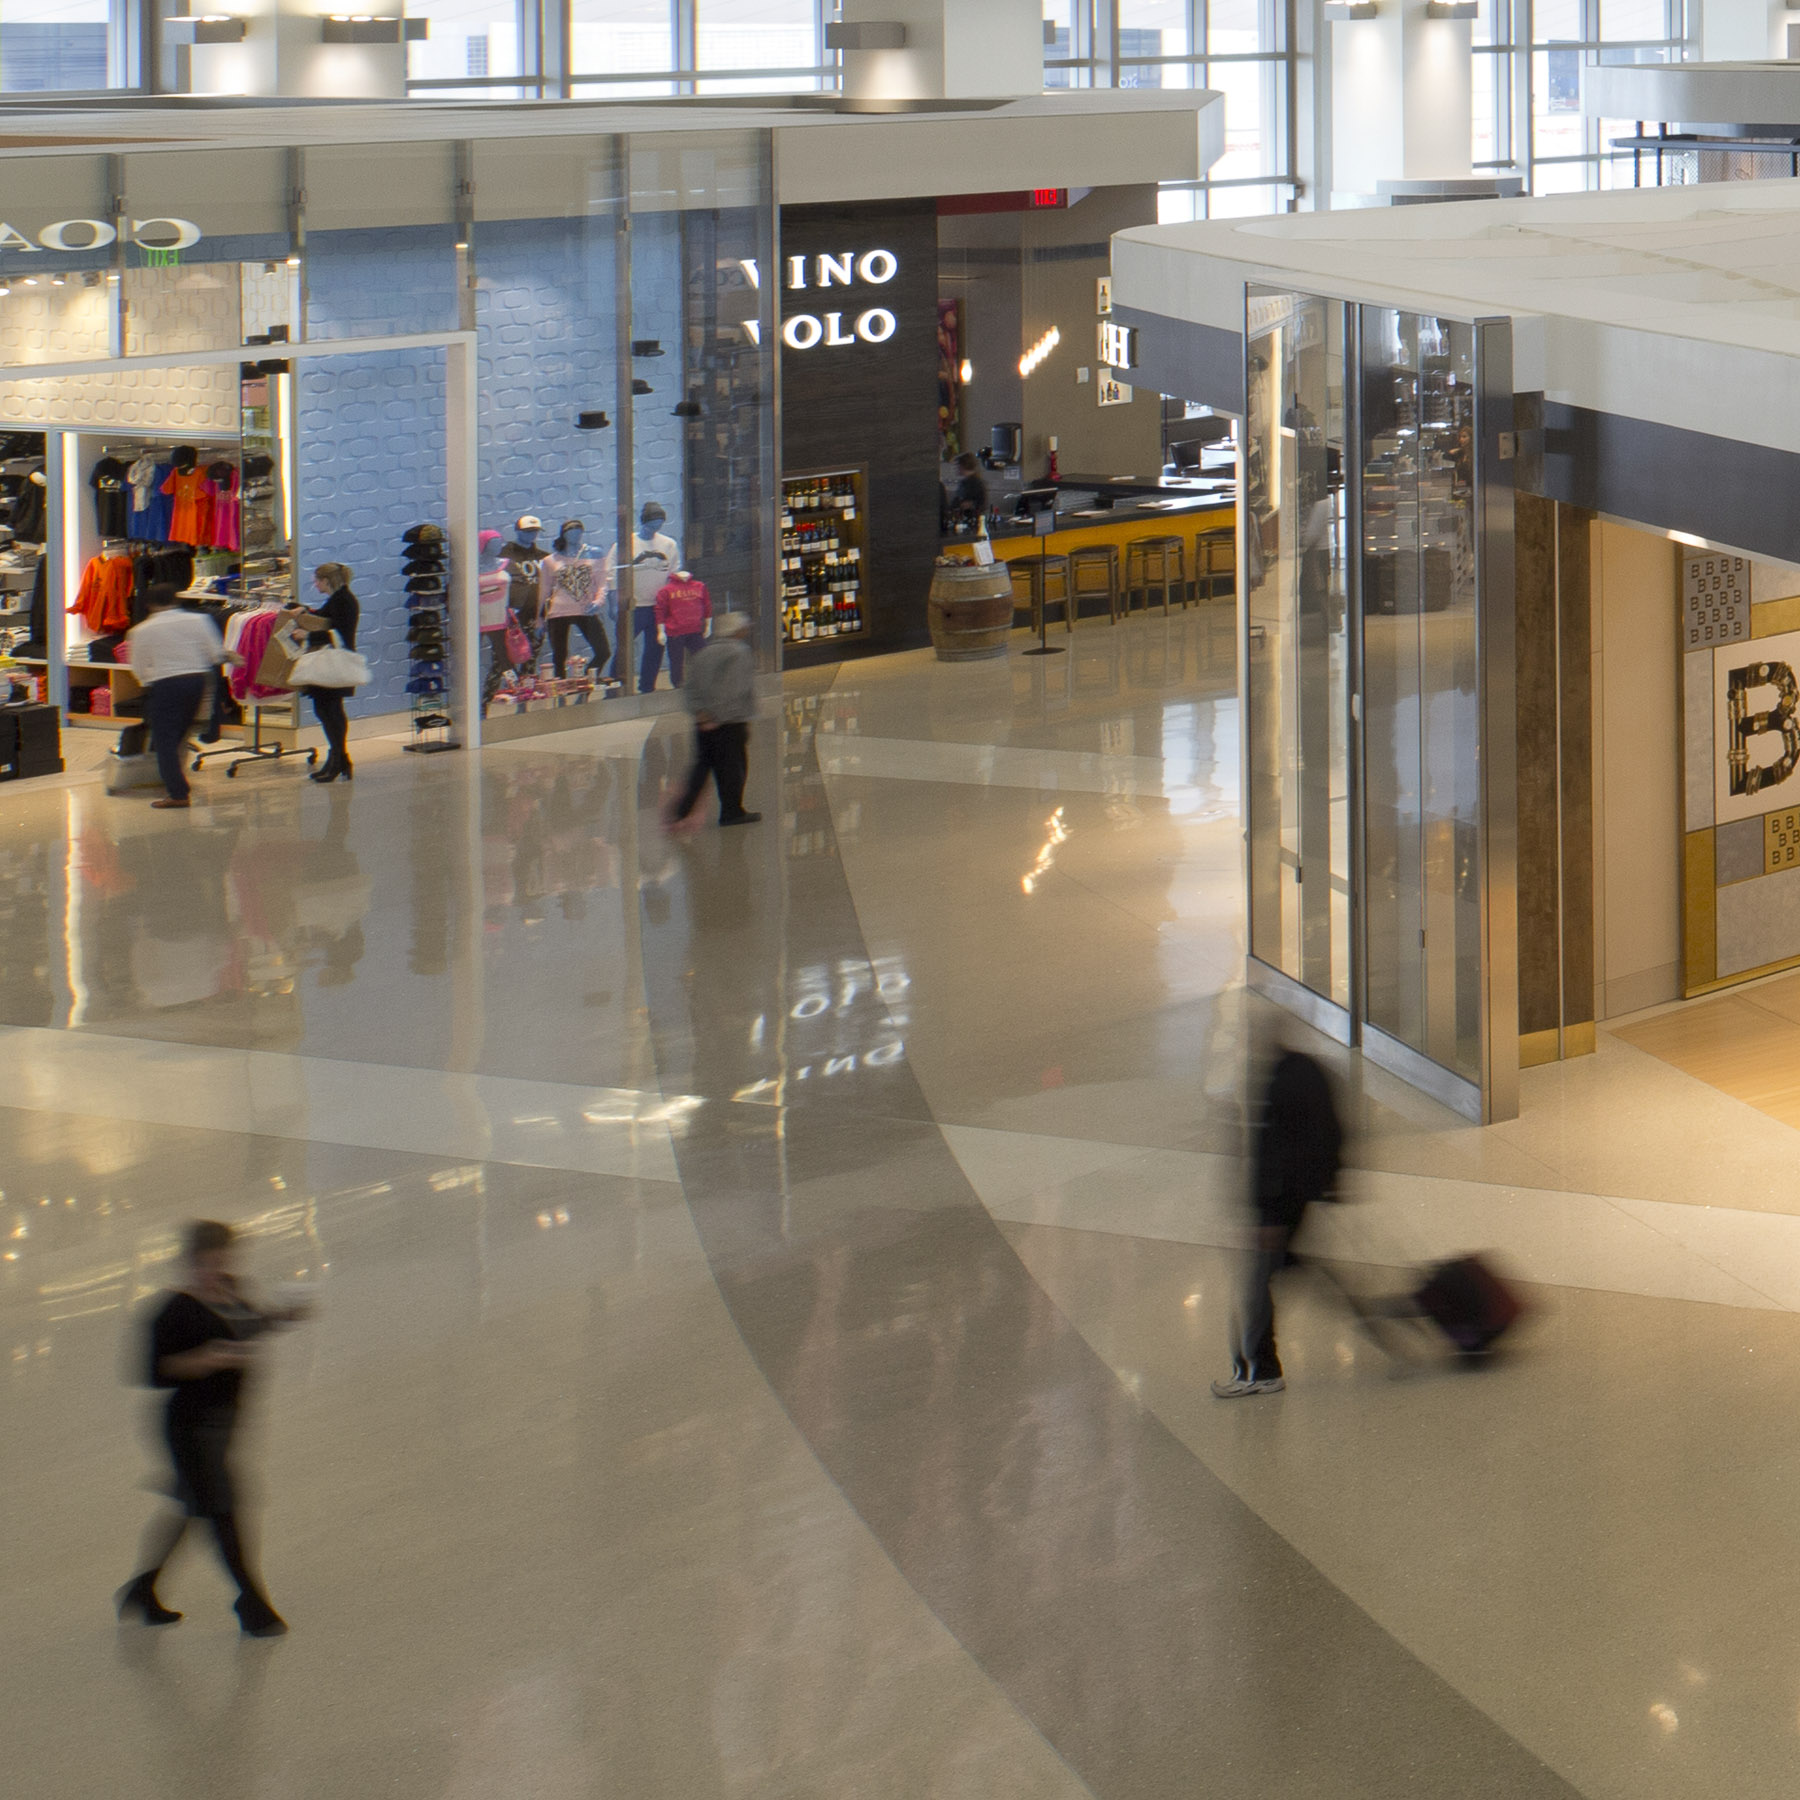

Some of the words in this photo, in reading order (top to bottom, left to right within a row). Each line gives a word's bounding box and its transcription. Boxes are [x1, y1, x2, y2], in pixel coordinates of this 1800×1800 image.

[1692, 564, 1700, 578] B
[1706, 562, 1714, 575] B
[1721, 559, 1729, 573] B
[1735, 558, 1743, 571] B
[1698, 579, 1706, 593] B
[1712, 576, 1721, 590] B
[1727, 574, 1735, 588] B
[1691, 597, 1699, 610] B
[1705, 594, 1713, 607] B
[1720, 591, 1728, 605] B
[1734, 590, 1742, 603] B
[1698, 611, 1706, 625] B
[1712, 609, 1721, 622] B
[1727, 607, 1735, 620] B
[1691, 629, 1699, 643] B
[1705, 626, 1713, 640] B
[1720, 624, 1728, 637] B
[1734, 622, 1742, 635] B
[1772, 819, 1780, 833] B
[1786, 815, 1794, 829] B
[1779, 833, 1787, 847] B
[1793, 829, 1800, 843] B
[1773, 850, 1781, 865] B
[1787, 847, 1794, 861] B
